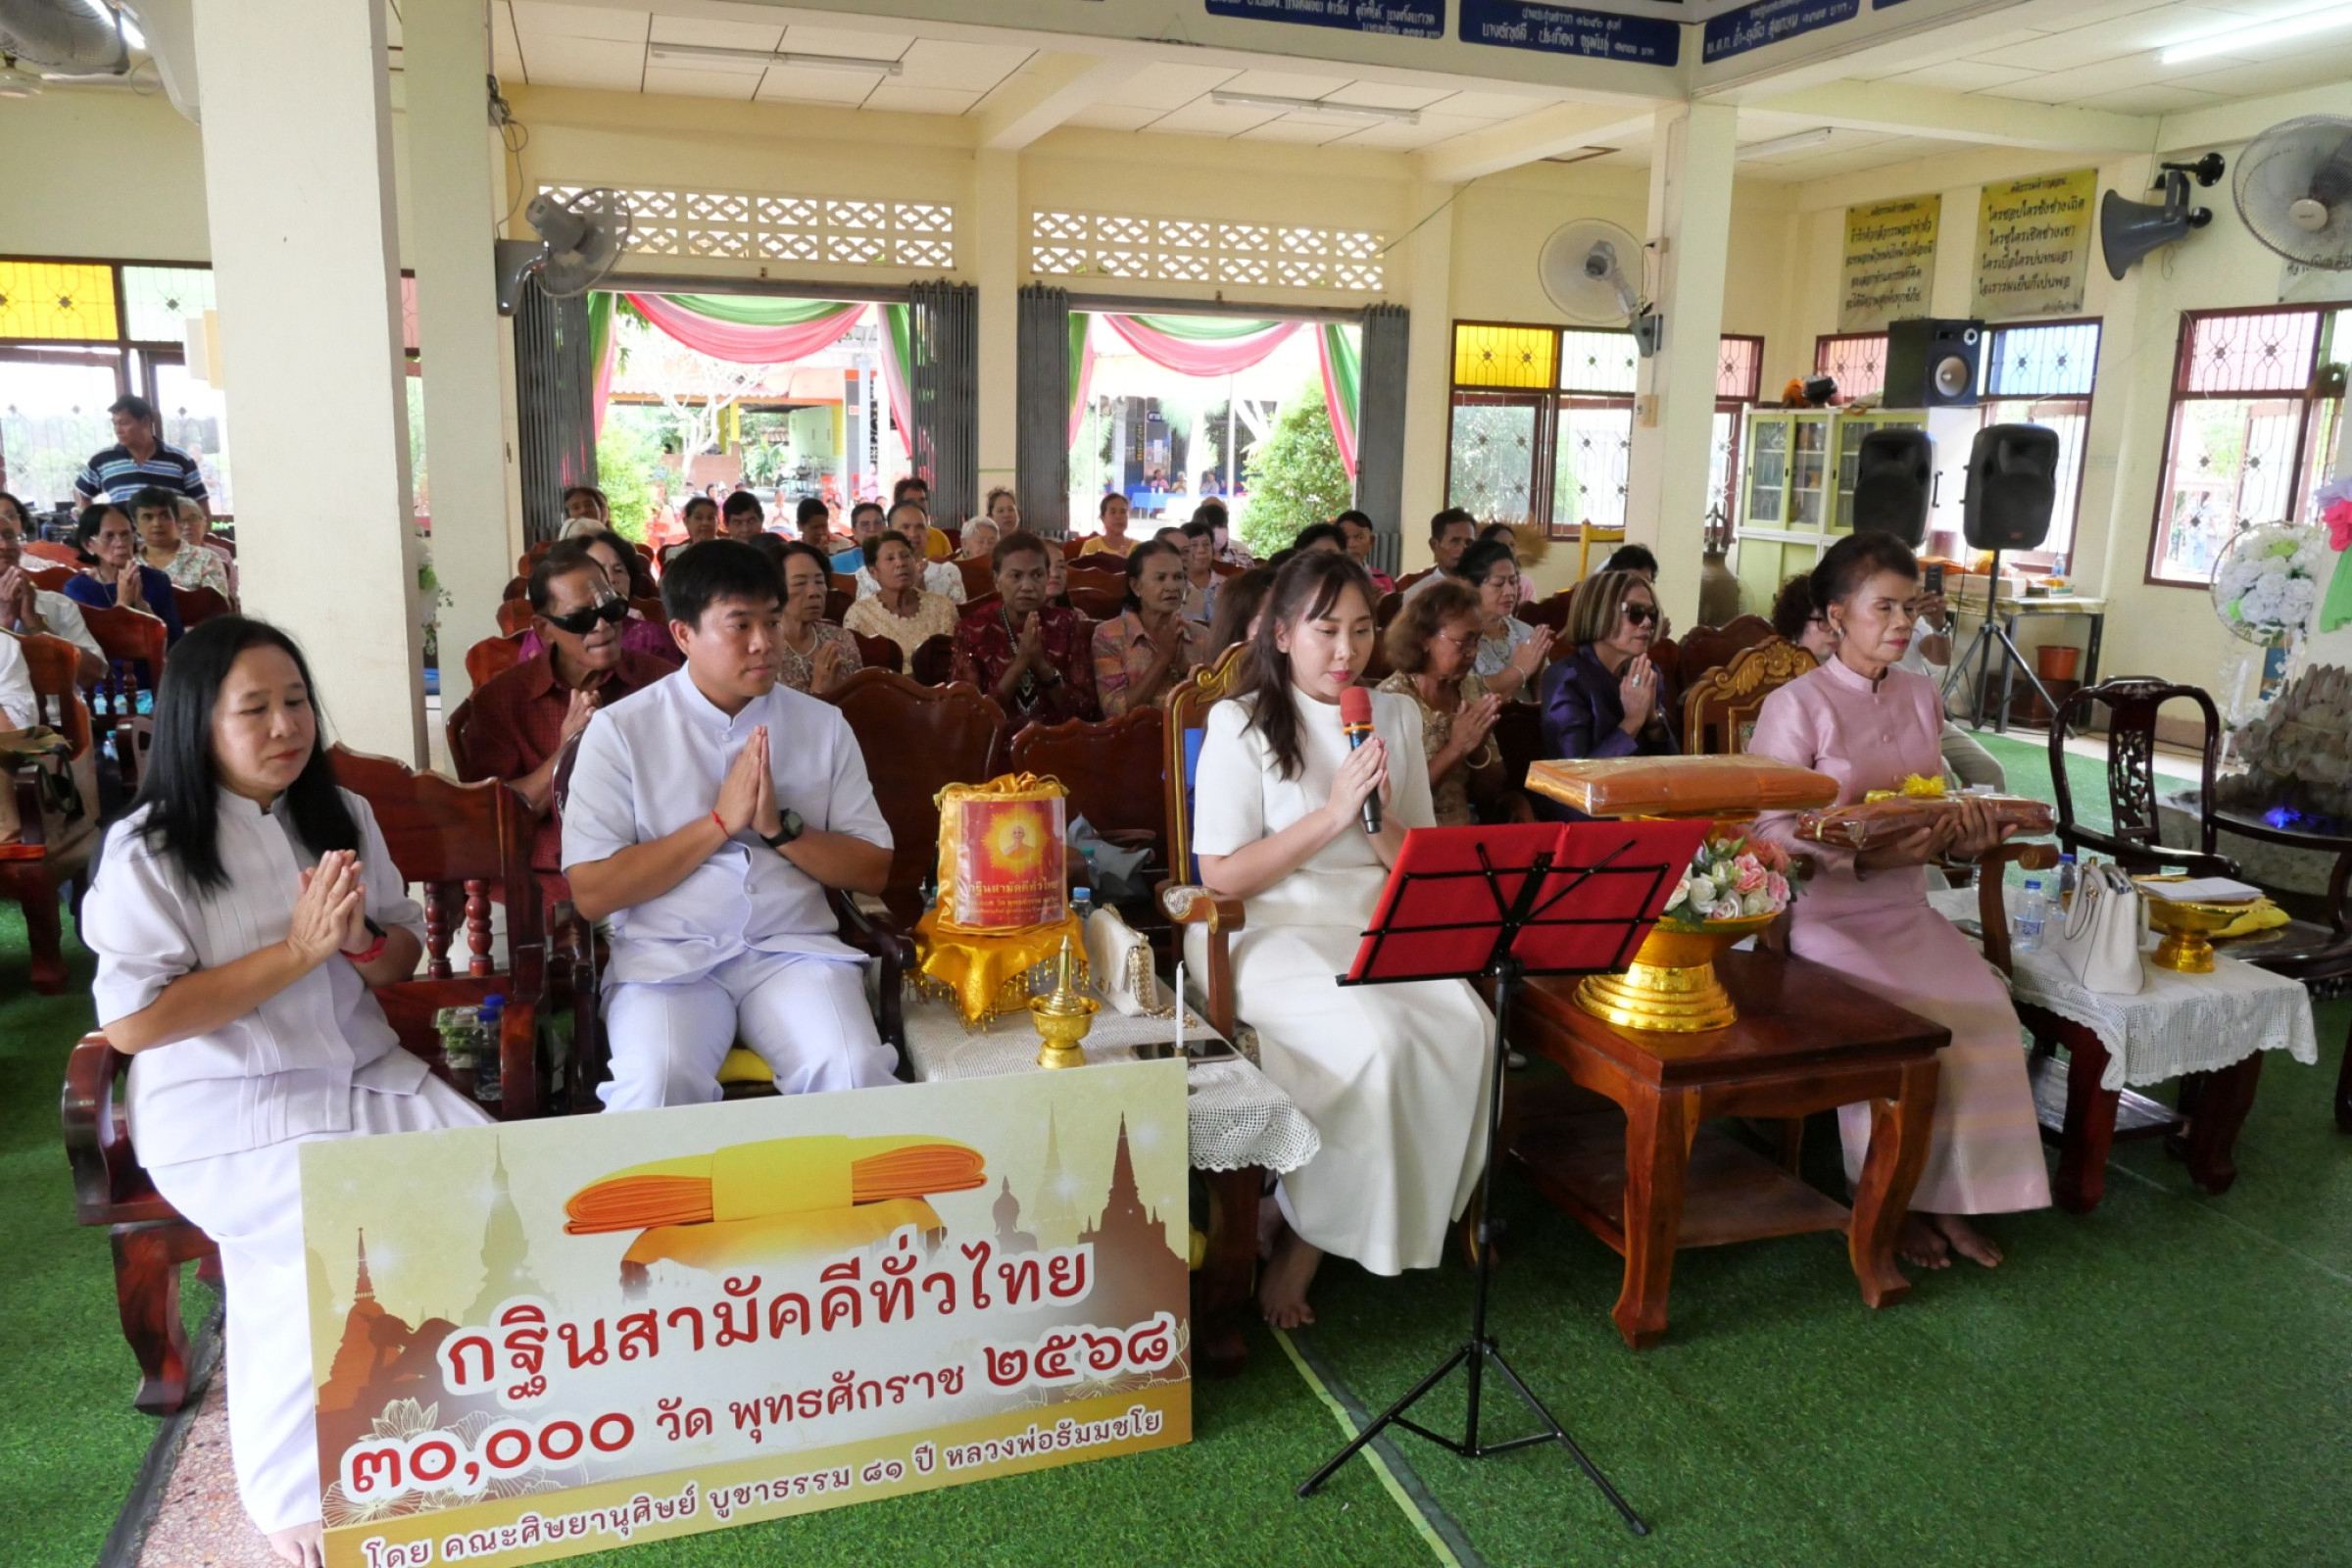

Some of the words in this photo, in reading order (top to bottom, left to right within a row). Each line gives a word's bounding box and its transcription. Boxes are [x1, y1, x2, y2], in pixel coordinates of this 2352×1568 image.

[449, 1236, 1088, 1400] กฐินสามัคคีทั่วไทย
[350, 1411, 635, 1494] ๓๐,๐๐๐
[656, 1397, 713, 1441] วัด
[728, 1361, 965, 1445] พุทธศักราช
[985, 1320, 1171, 1389] ๒๕๖๘
[367, 1544, 429, 1568] โดย
[446, 1484, 697, 1558] คณะศิษยานุศิษย์
[710, 1469, 851, 1517] บูชาธรรม
[862, 1461, 904, 1483] ๘๑
[915, 1446, 935, 1472] ปี
[947, 1408, 1162, 1467] หลวงพ่อธัมมชโย
